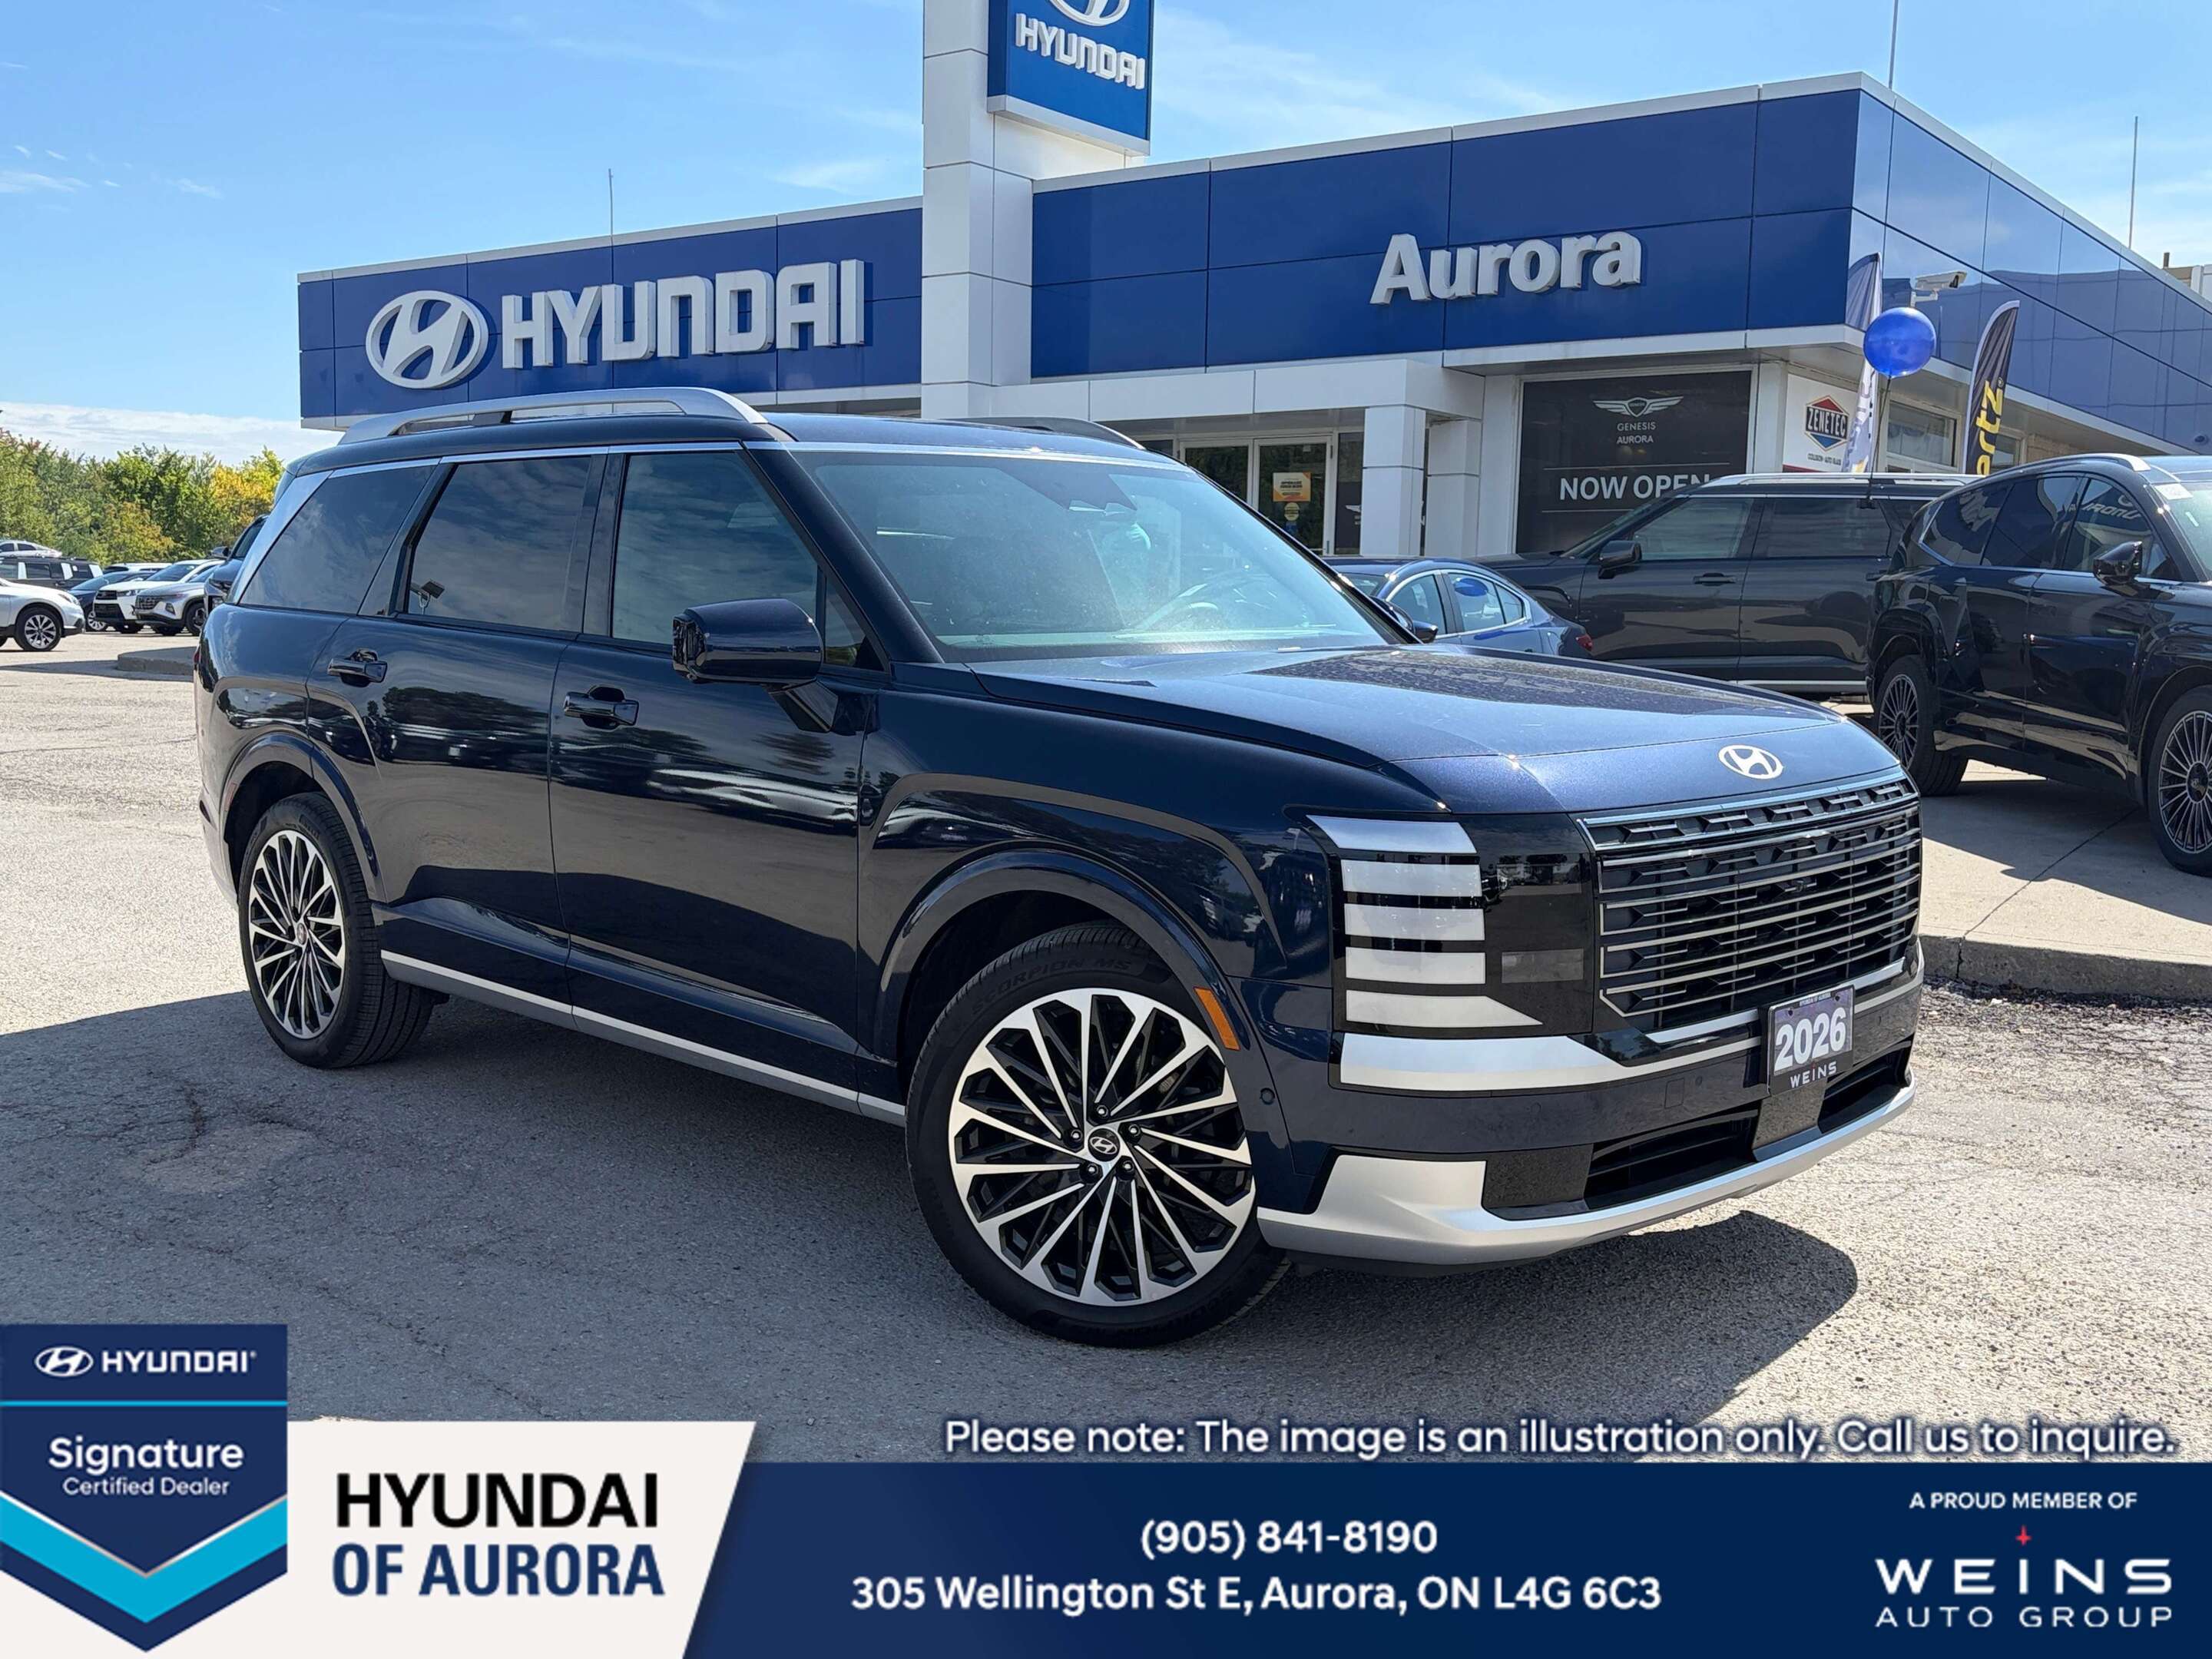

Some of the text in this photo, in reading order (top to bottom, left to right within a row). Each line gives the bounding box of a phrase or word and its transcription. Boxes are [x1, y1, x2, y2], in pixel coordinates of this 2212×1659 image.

[1015, 13, 1146, 90] HYUNDAI
[1370, 230, 1642, 306] Aurora
[501, 259, 866, 370] HYUNDAI
[1617, 422, 1657, 432] GENESIS
[1806, 408, 1846, 438] ZENETEC
[1616, 435, 1654, 445] AURORA
[1559, 475, 1628, 501] NOW
[1774, 1007, 1846, 1072] 2026
[1790, 1061, 1837, 1088] WEINS
